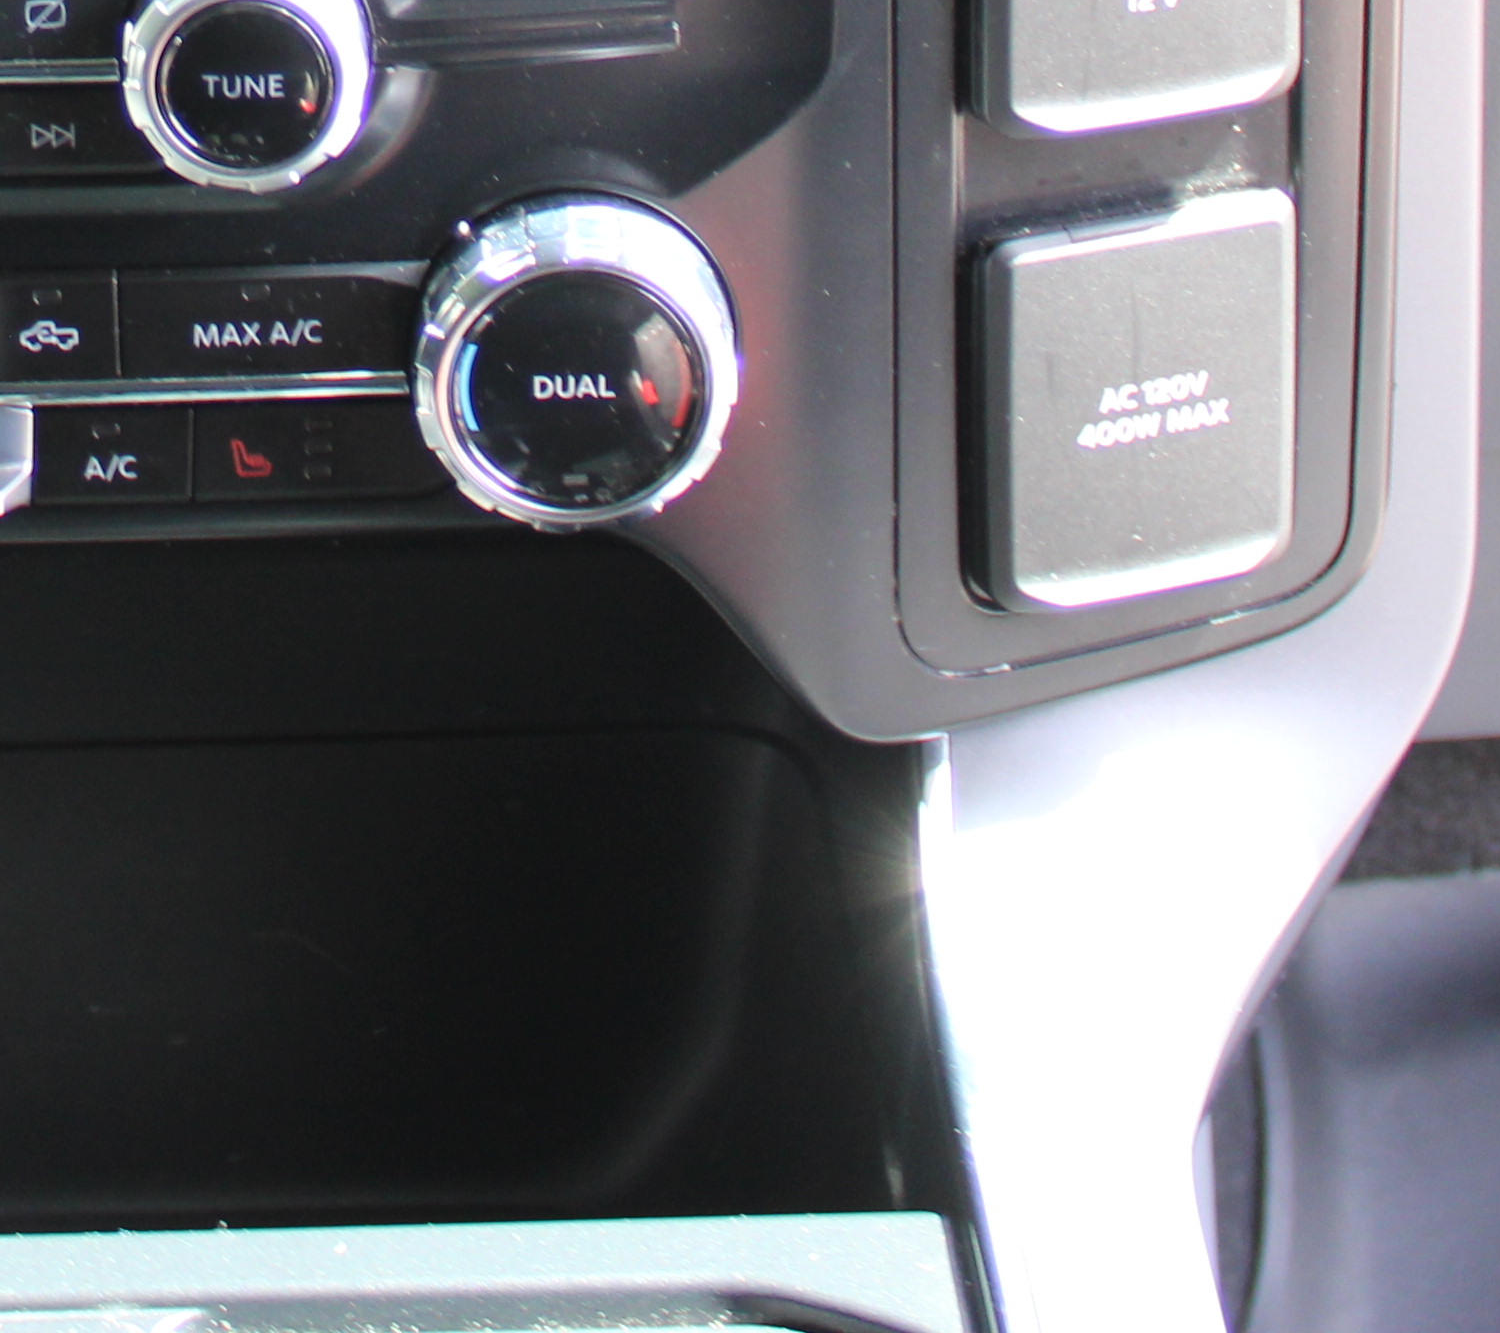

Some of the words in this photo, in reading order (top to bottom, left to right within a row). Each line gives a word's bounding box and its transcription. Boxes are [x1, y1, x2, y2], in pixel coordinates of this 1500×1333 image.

[202, 73, 286, 101] TUNE
[192, 321, 261, 350] MAX
[269, 317, 323, 347] A/C
[531, 372, 617, 401] DUAL
[1100, 385, 1138, 415] AC
[1140, 370, 1209, 409] 120V
[1076, 412, 1162, 450] 400W
[1166, 397, 1230, 433] MAX
[83, 454, 138, 482] A/C
